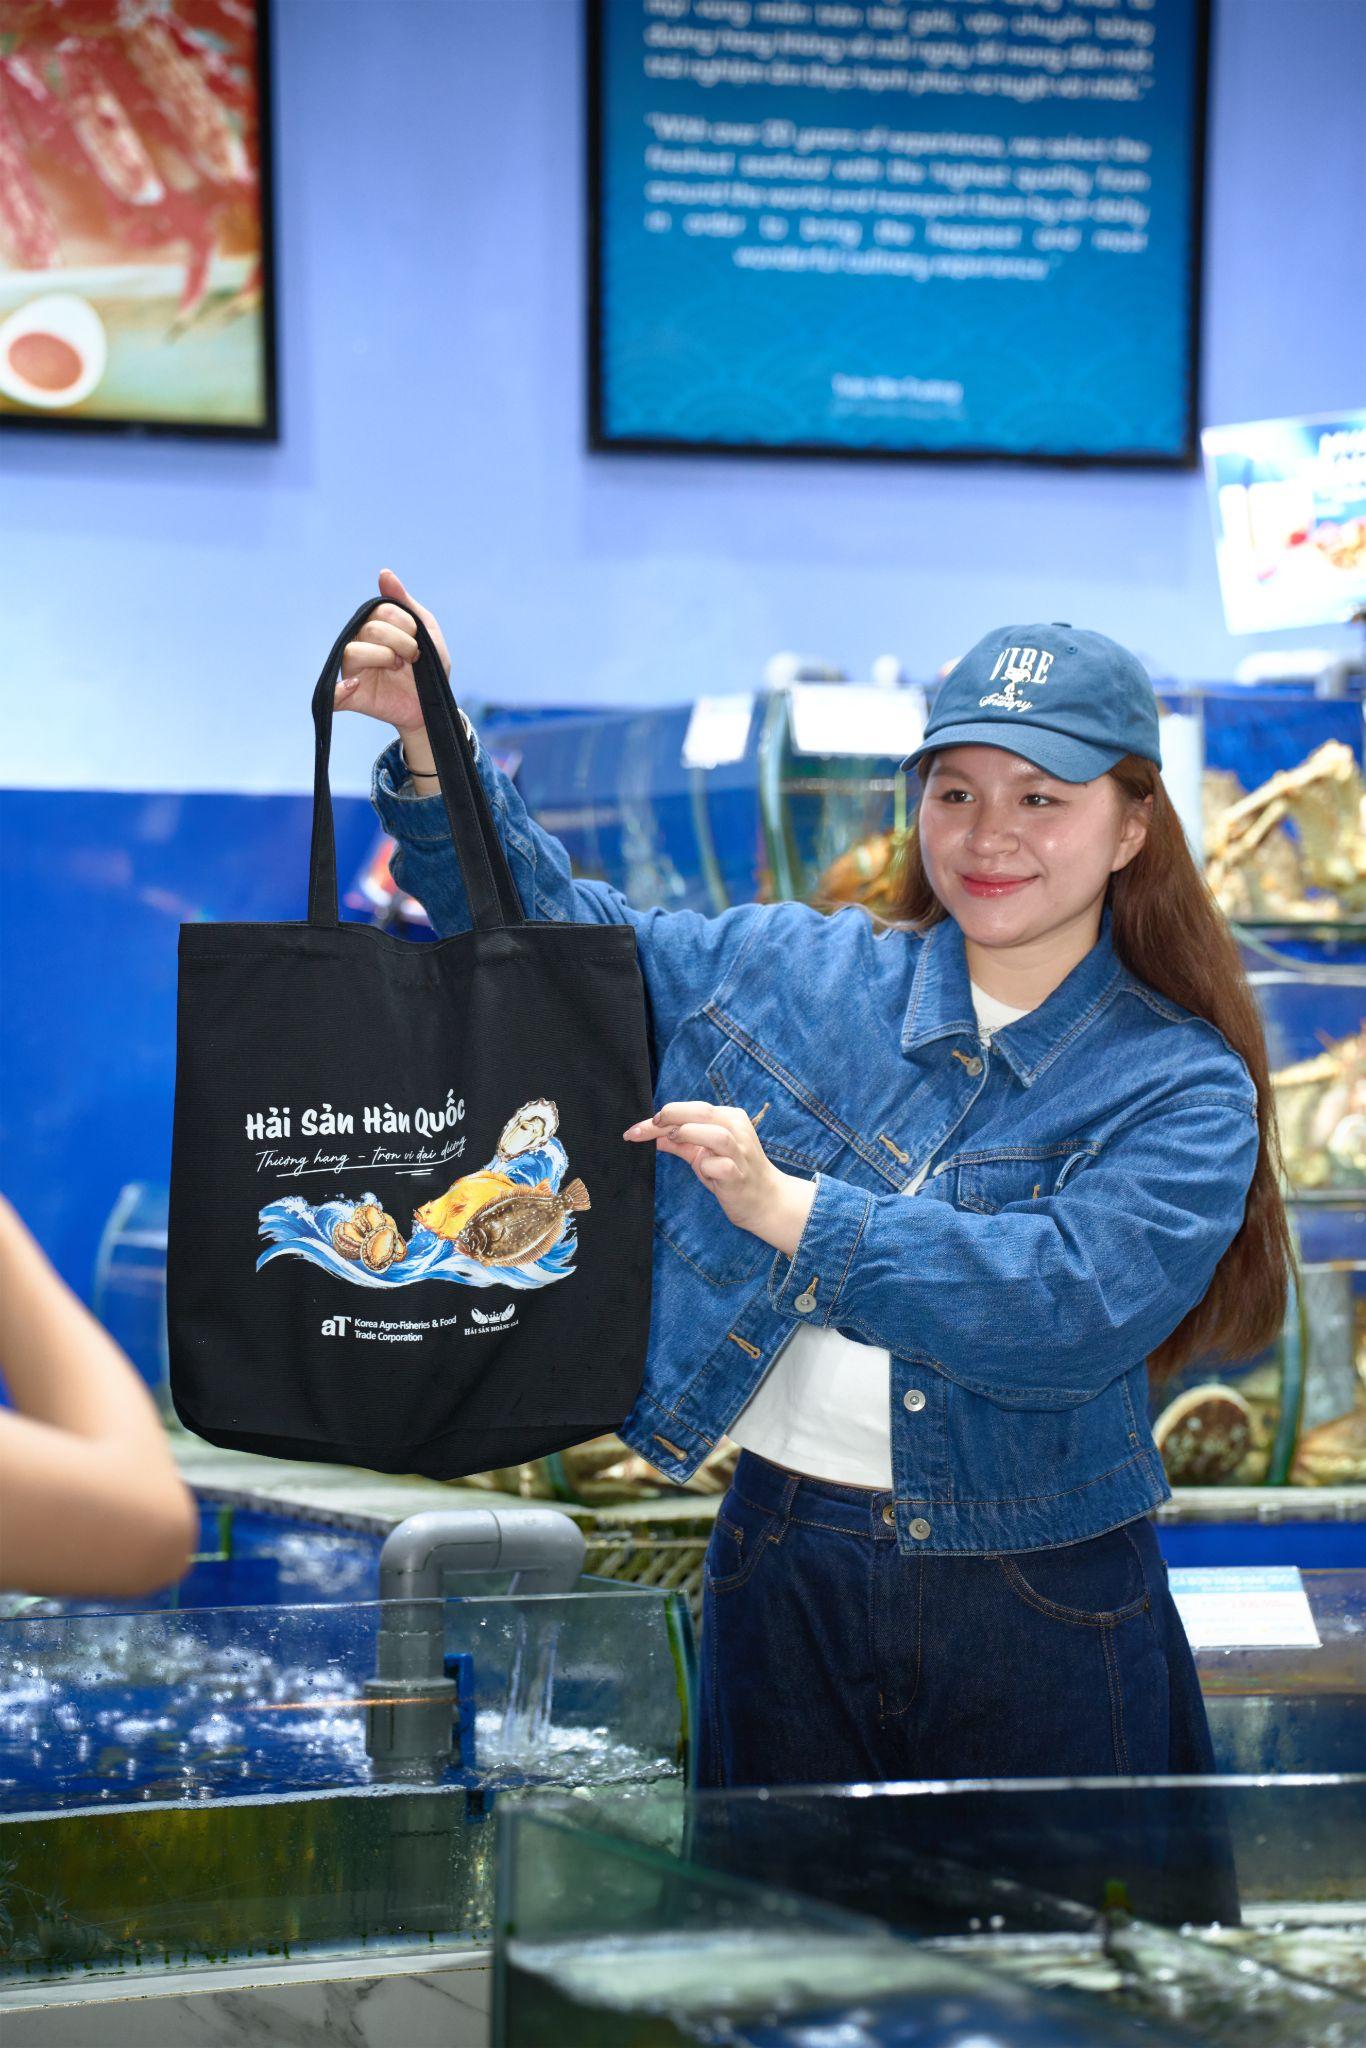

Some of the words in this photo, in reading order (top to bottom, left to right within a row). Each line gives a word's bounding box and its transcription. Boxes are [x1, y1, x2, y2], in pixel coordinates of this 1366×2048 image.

[989, 647, 1055, 684] VIBE
[244, 1106, 291, 1141] Hải
[301, 1102, 354, 1136] Sản
[362, 1102, 411, 1134] Hàn
[414, 1088, 466, 1139] Quốc
[313, 1148, 350, 1174] hạng
[321, 1315, 352, 1337] aT
[354, 1318, 378, 1329] Korea
[379, 1320, 431, 1332] Agro-Fisheries
[432, 1319, 439, 1328] &
[440, 1315, 457, 1327] Food
[354, 1330, 377, 1340] Trade
[378, 1332, 423, 1343] Corporation
